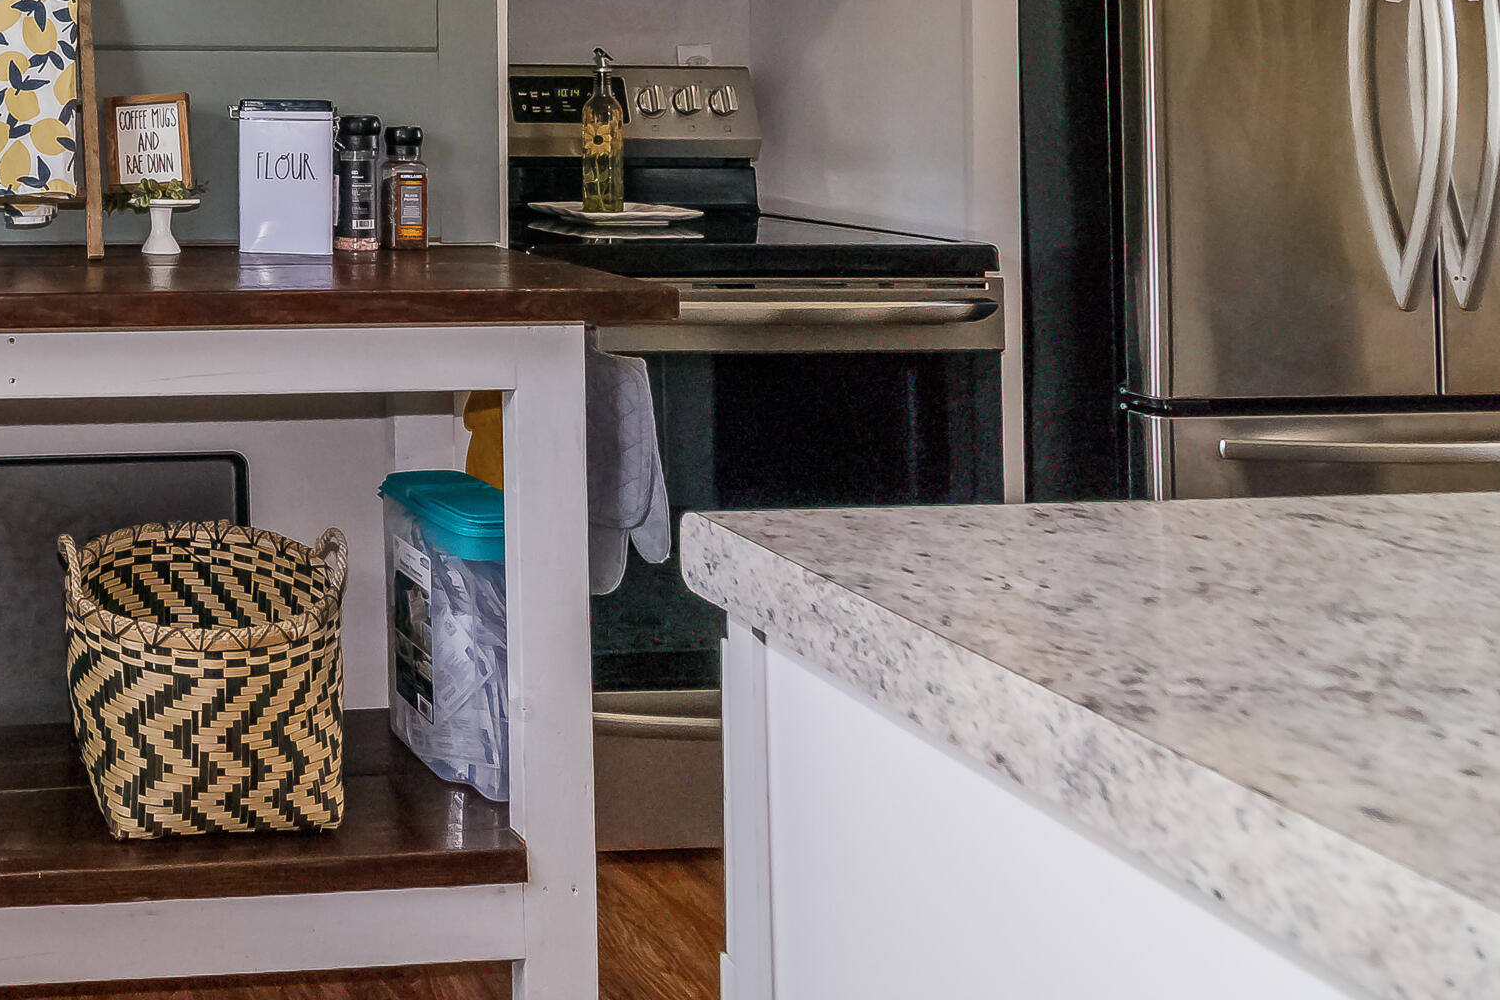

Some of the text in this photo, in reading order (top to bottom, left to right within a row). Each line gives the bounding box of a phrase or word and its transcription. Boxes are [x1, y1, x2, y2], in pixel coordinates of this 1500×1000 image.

[118, 107, 177, 131] COFFEE MUGS
[137, 131, 160, 153] AND
[125, 152, 174, 175] RAE DUNN
